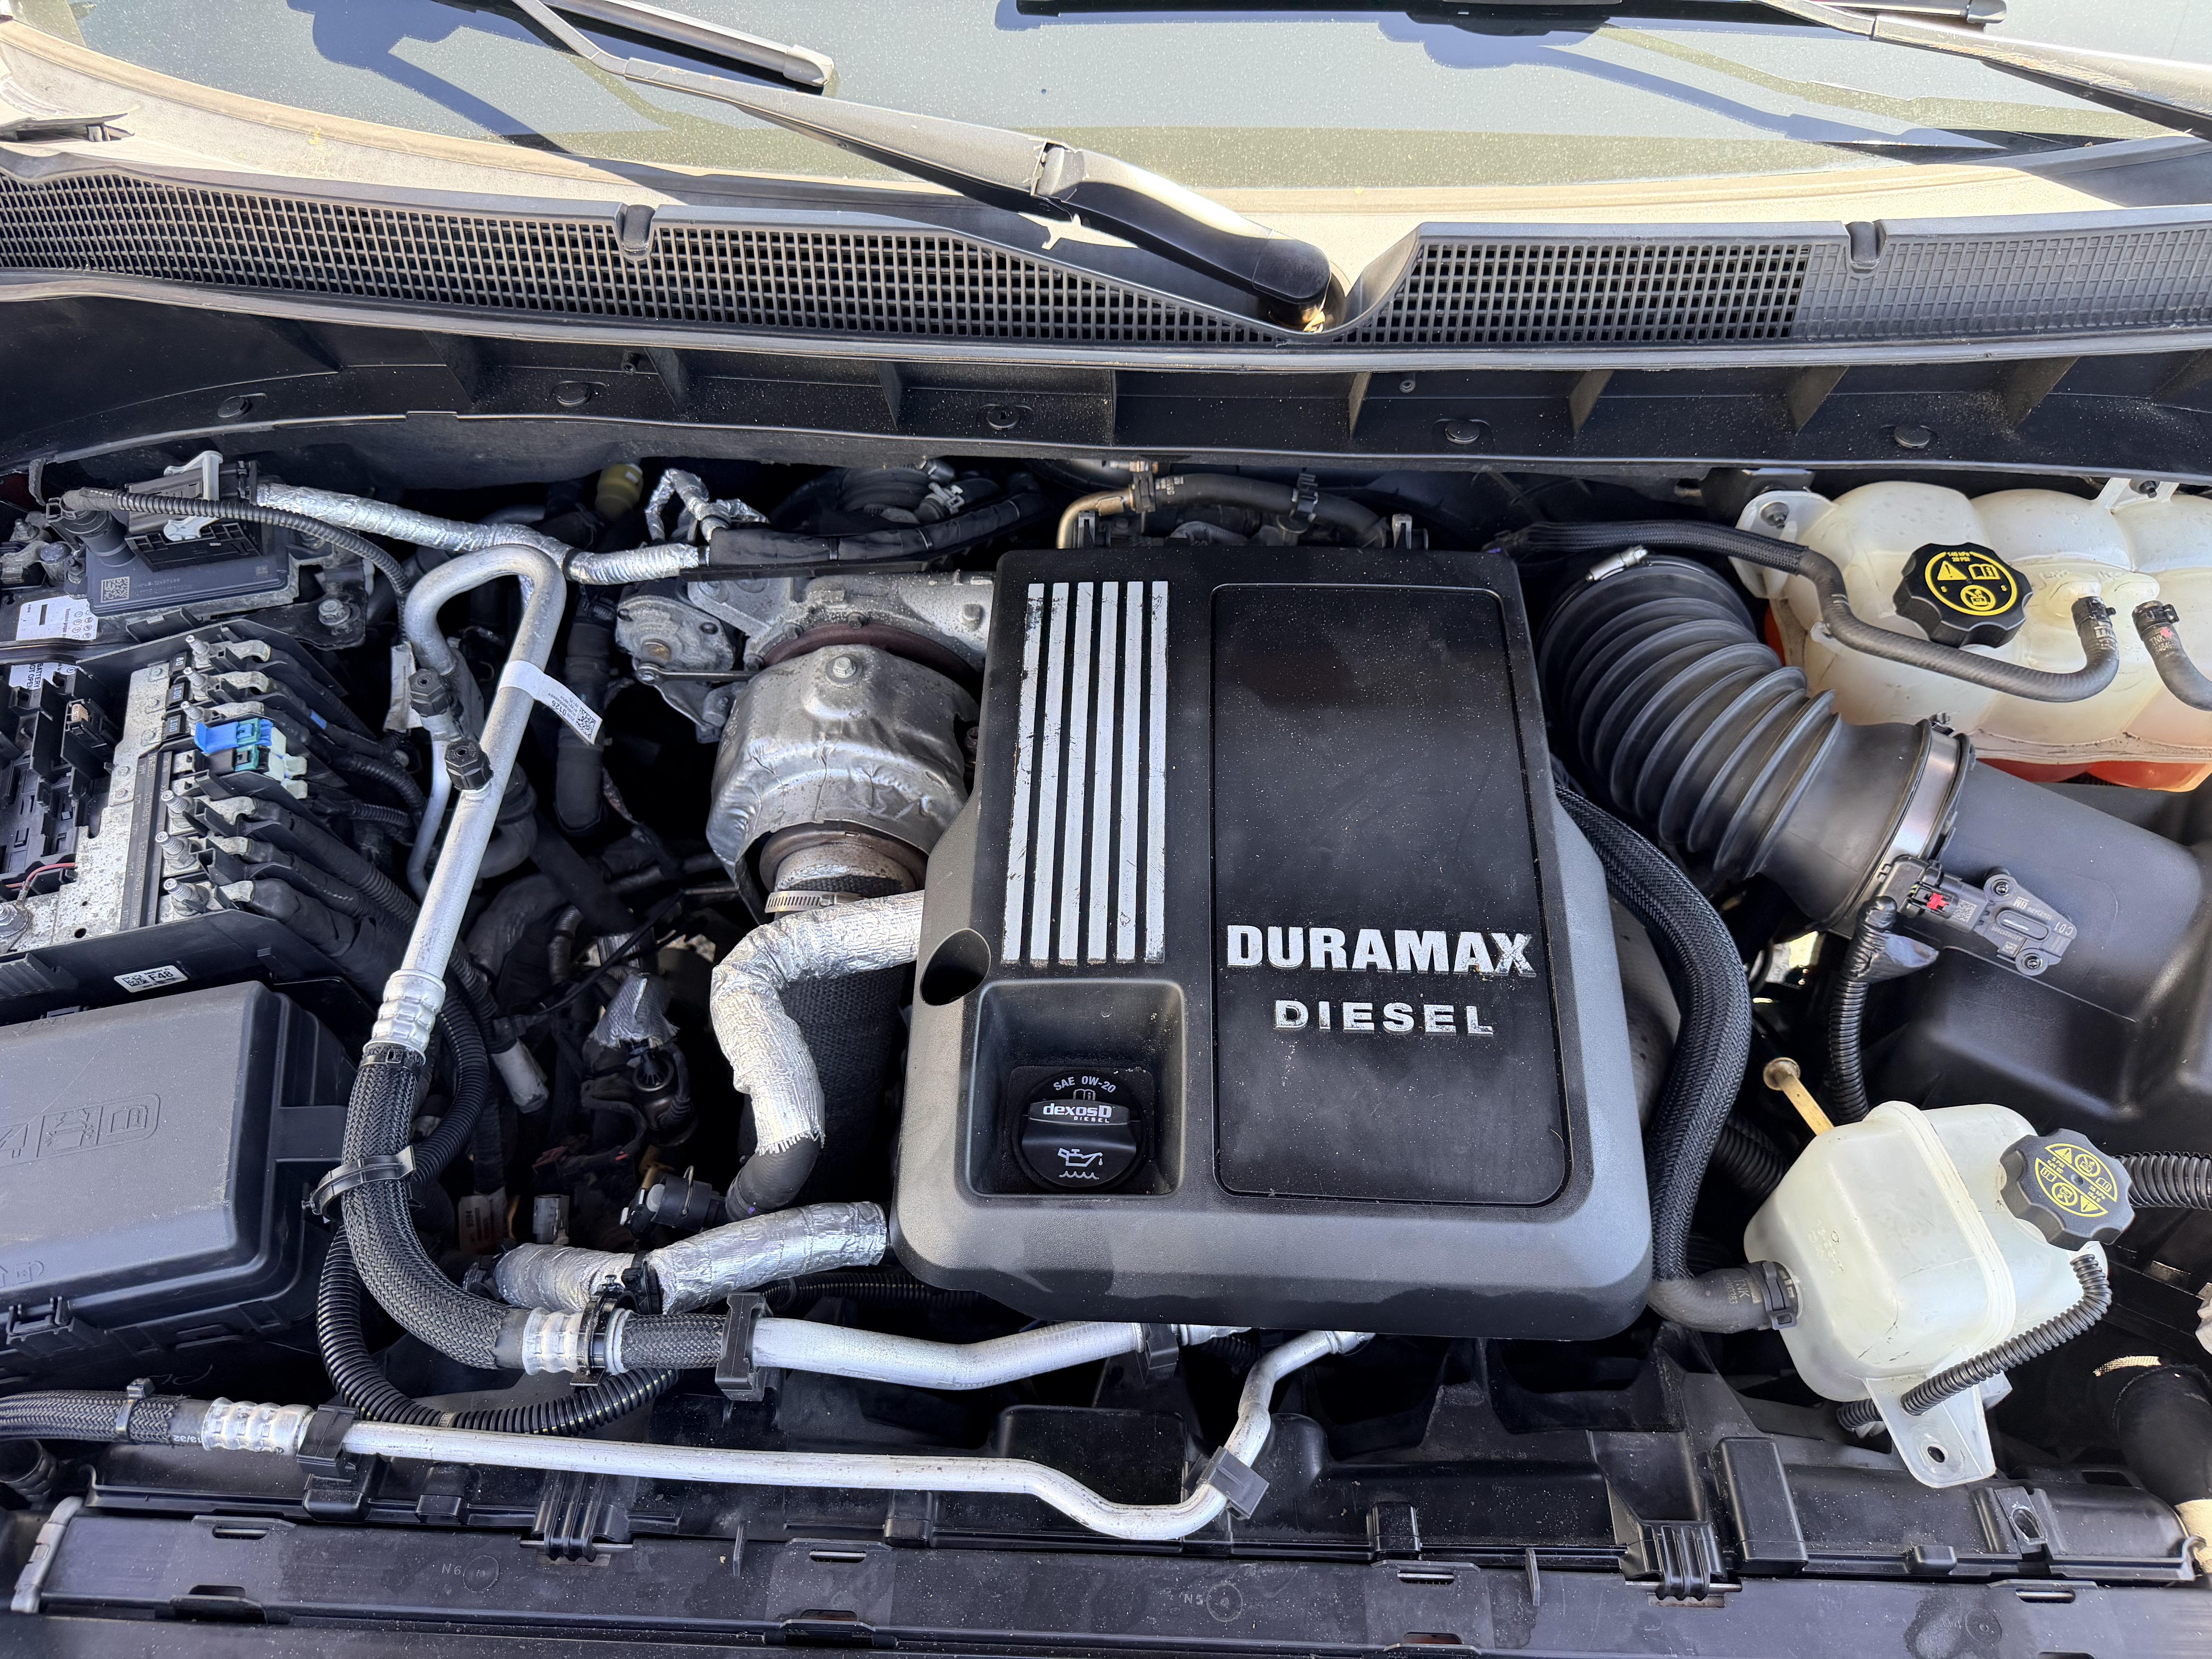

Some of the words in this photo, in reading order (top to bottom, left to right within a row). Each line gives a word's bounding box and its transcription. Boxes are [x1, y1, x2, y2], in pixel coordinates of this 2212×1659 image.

[34, 663, 43, 688] BATTERY
[173, 686, 182, 700] 100
[551, 700, 567, 716] 0126
[170, 717, 179, 732] 100
[2014, 896, 2029, 910] GM
[2054, 921, 2074, 936] C01
[1226, 924, 1537, 978] DURAMAX
[148, 971, 173, 981] F48
[1274, 1000, 1494, 1036] DIESEL
[1053, 1077, 1075, 1091] SAE
[1081, 1076, 1116, 1093] 0W-20
[1043, 1103, 1112, 1118] dexosD
[2055, 1159, 2065, 1168] PSI
